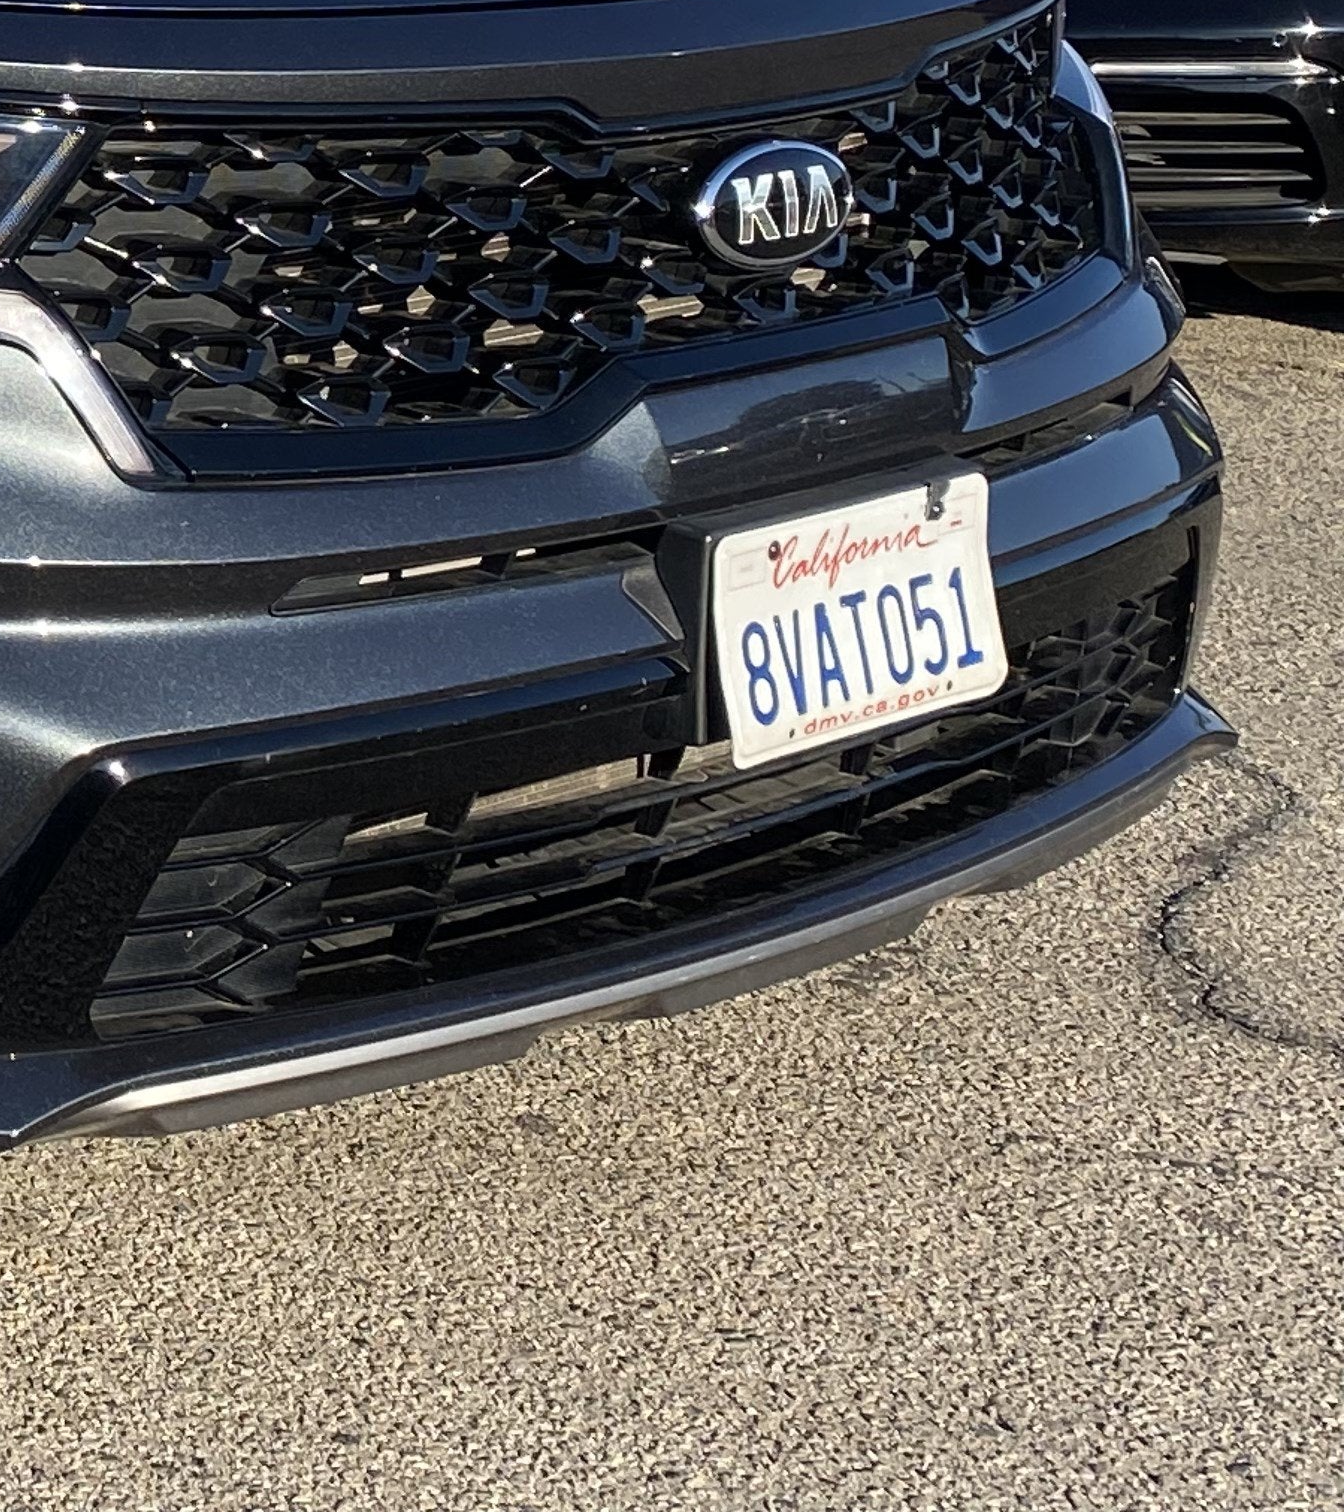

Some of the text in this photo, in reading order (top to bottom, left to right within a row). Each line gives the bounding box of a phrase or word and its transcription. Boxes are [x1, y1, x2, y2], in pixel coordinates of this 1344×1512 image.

[731, 164, 838, 246] KIA
[773, 522, 939, 590] California
[741, 565, 984, 726] 8VAT051
[803, 685, 940, 735] dmv.ca.gov
